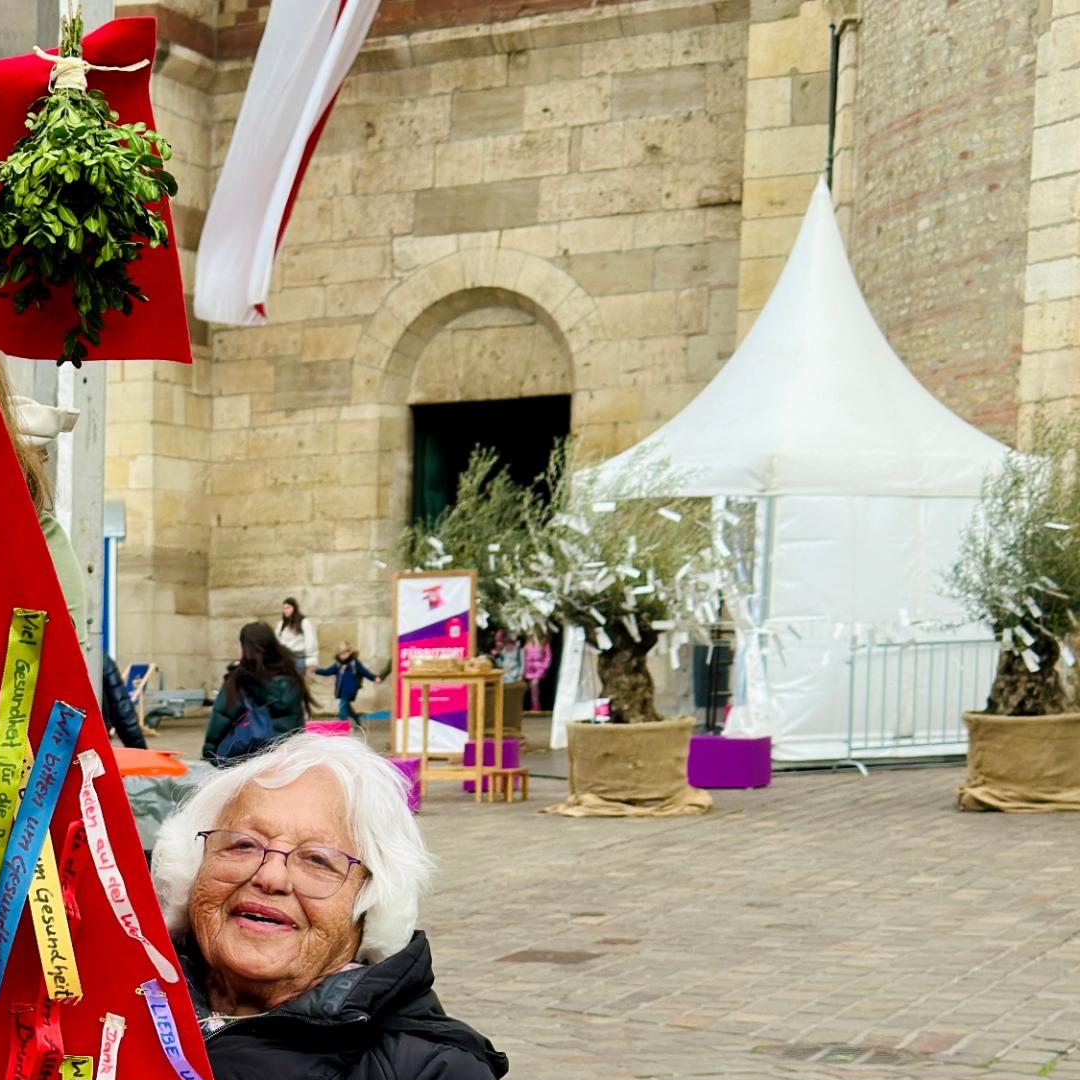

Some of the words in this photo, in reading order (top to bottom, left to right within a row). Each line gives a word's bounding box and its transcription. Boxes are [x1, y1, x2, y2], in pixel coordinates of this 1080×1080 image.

[52, 709, 75, 746] Wir
[31, 752, 61, 809] bitten
[18, 815, 39, 852] um
[94, 838, 116, 871] auf
[35, 887, 75, 1001] Gesundheit
[100, 1025, 119, 1075] Dank
[150, 1002, 180, 1060] LIEBE
